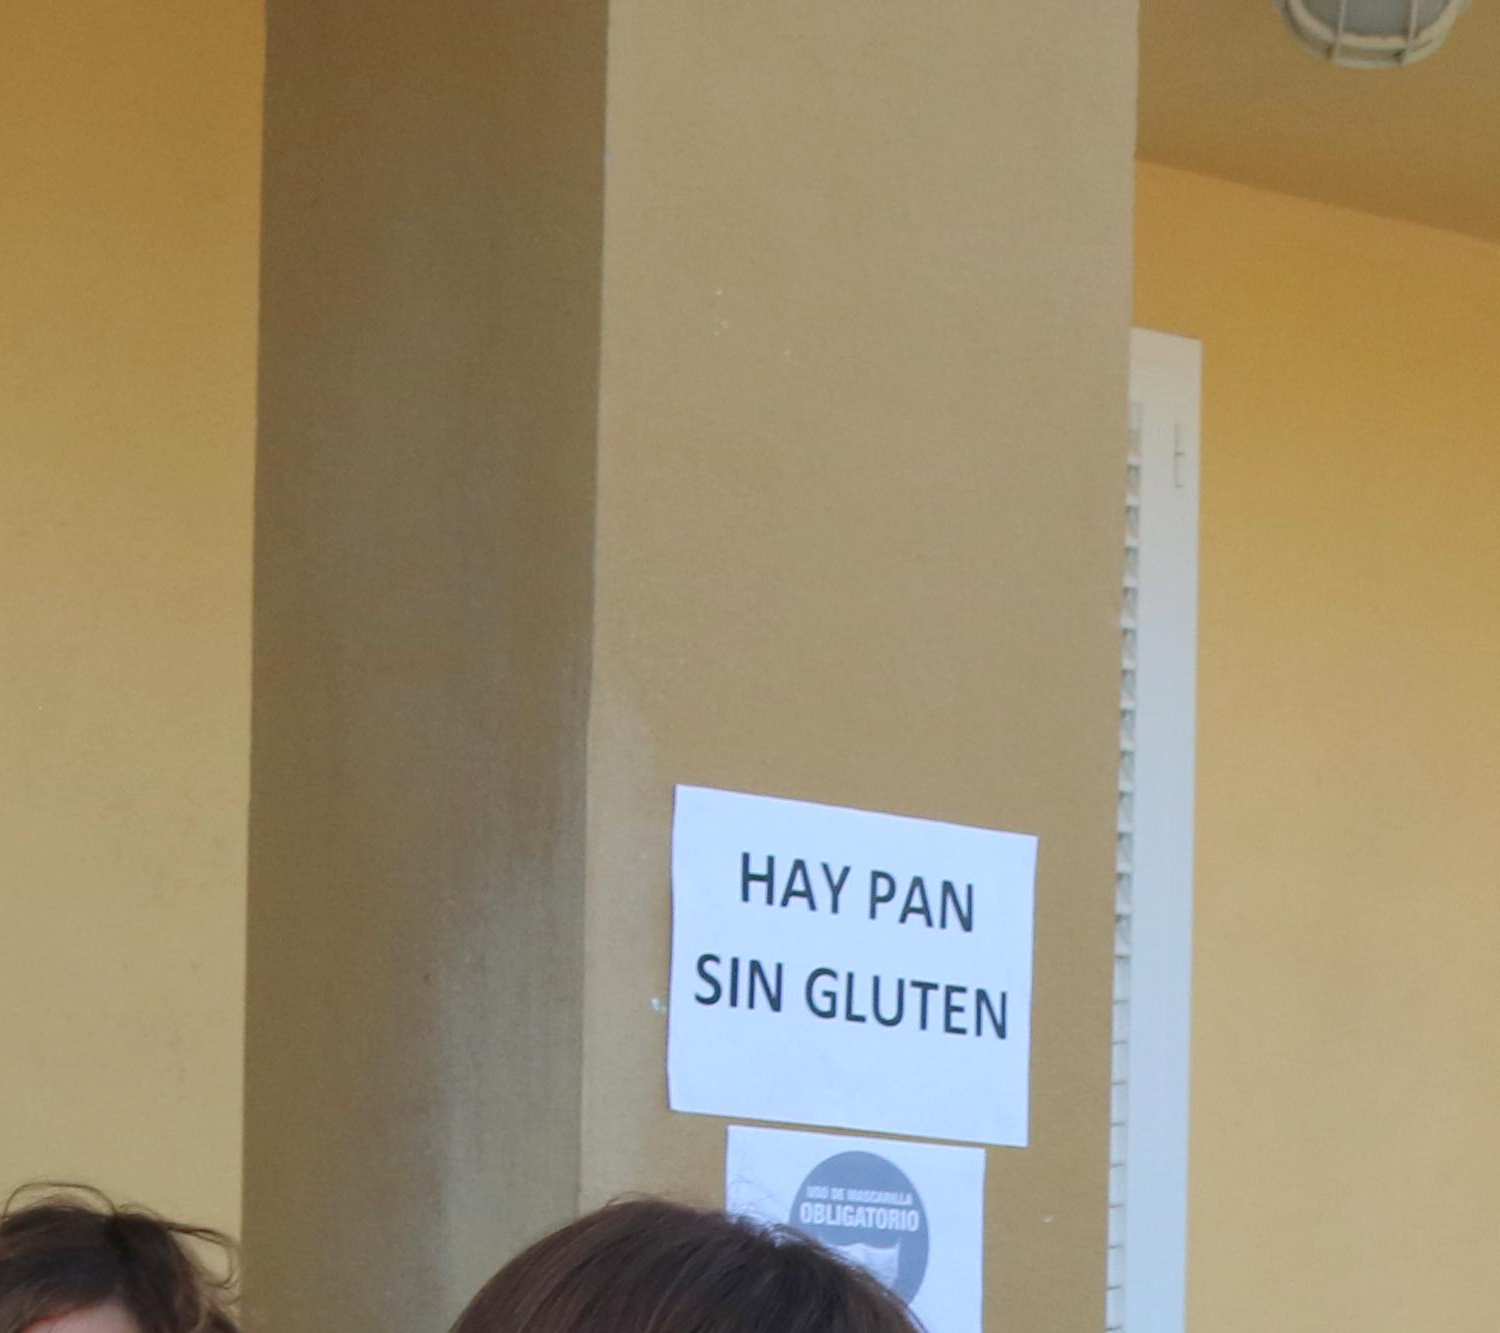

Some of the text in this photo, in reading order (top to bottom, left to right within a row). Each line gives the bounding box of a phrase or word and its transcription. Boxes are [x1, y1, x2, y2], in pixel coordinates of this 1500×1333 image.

[741, 851, 974, 933] HAY PAN
[695, 953, 1007, 1040] SIN GLUTEN
[800, 1201, 920, 1233] OBLIGATORIO
[805, 1185, 915, 1206] USO DE MASCARILLA
